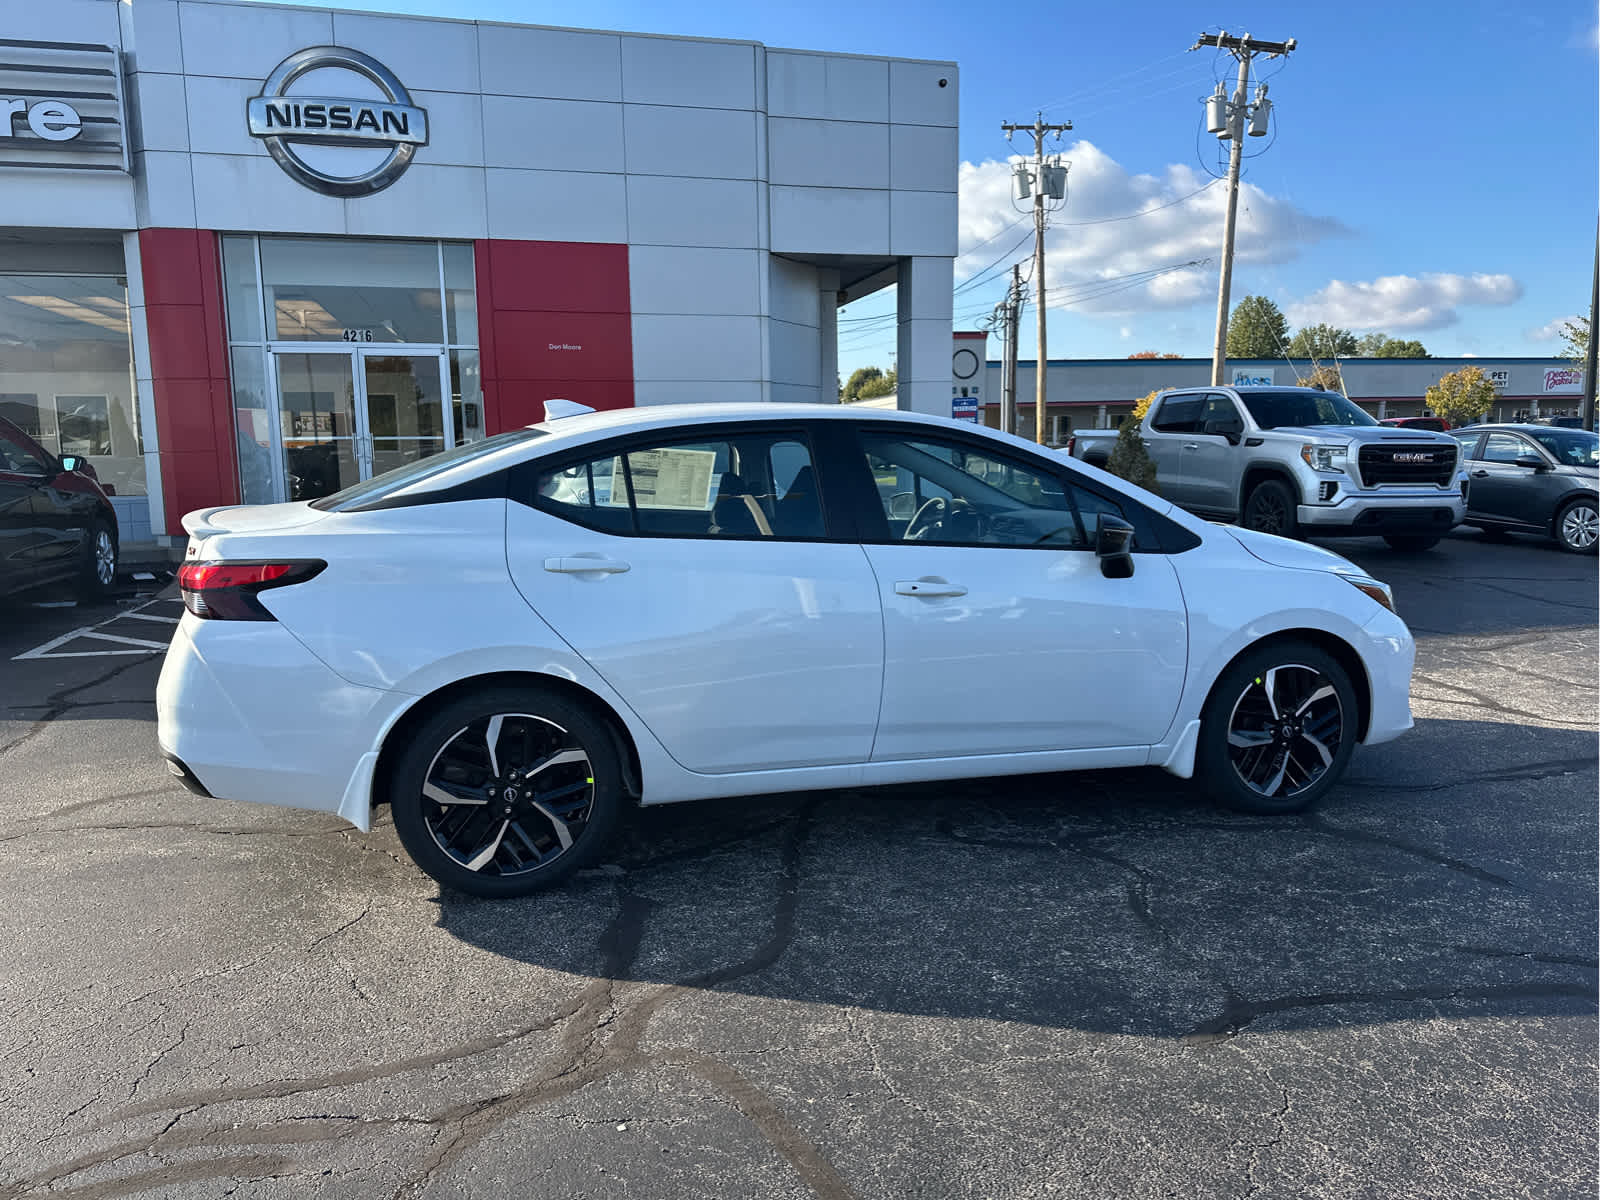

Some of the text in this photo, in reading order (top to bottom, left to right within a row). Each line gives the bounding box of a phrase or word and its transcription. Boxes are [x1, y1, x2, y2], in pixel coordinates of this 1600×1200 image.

[265, 103, 410, 135] NISSAN
[343, 329, 373, 342] 4216
[548, 343, 582, 351] Don Moore
[1492, 371, 1508, 379] PET
[1393, 452, 1434, 463] GMC
